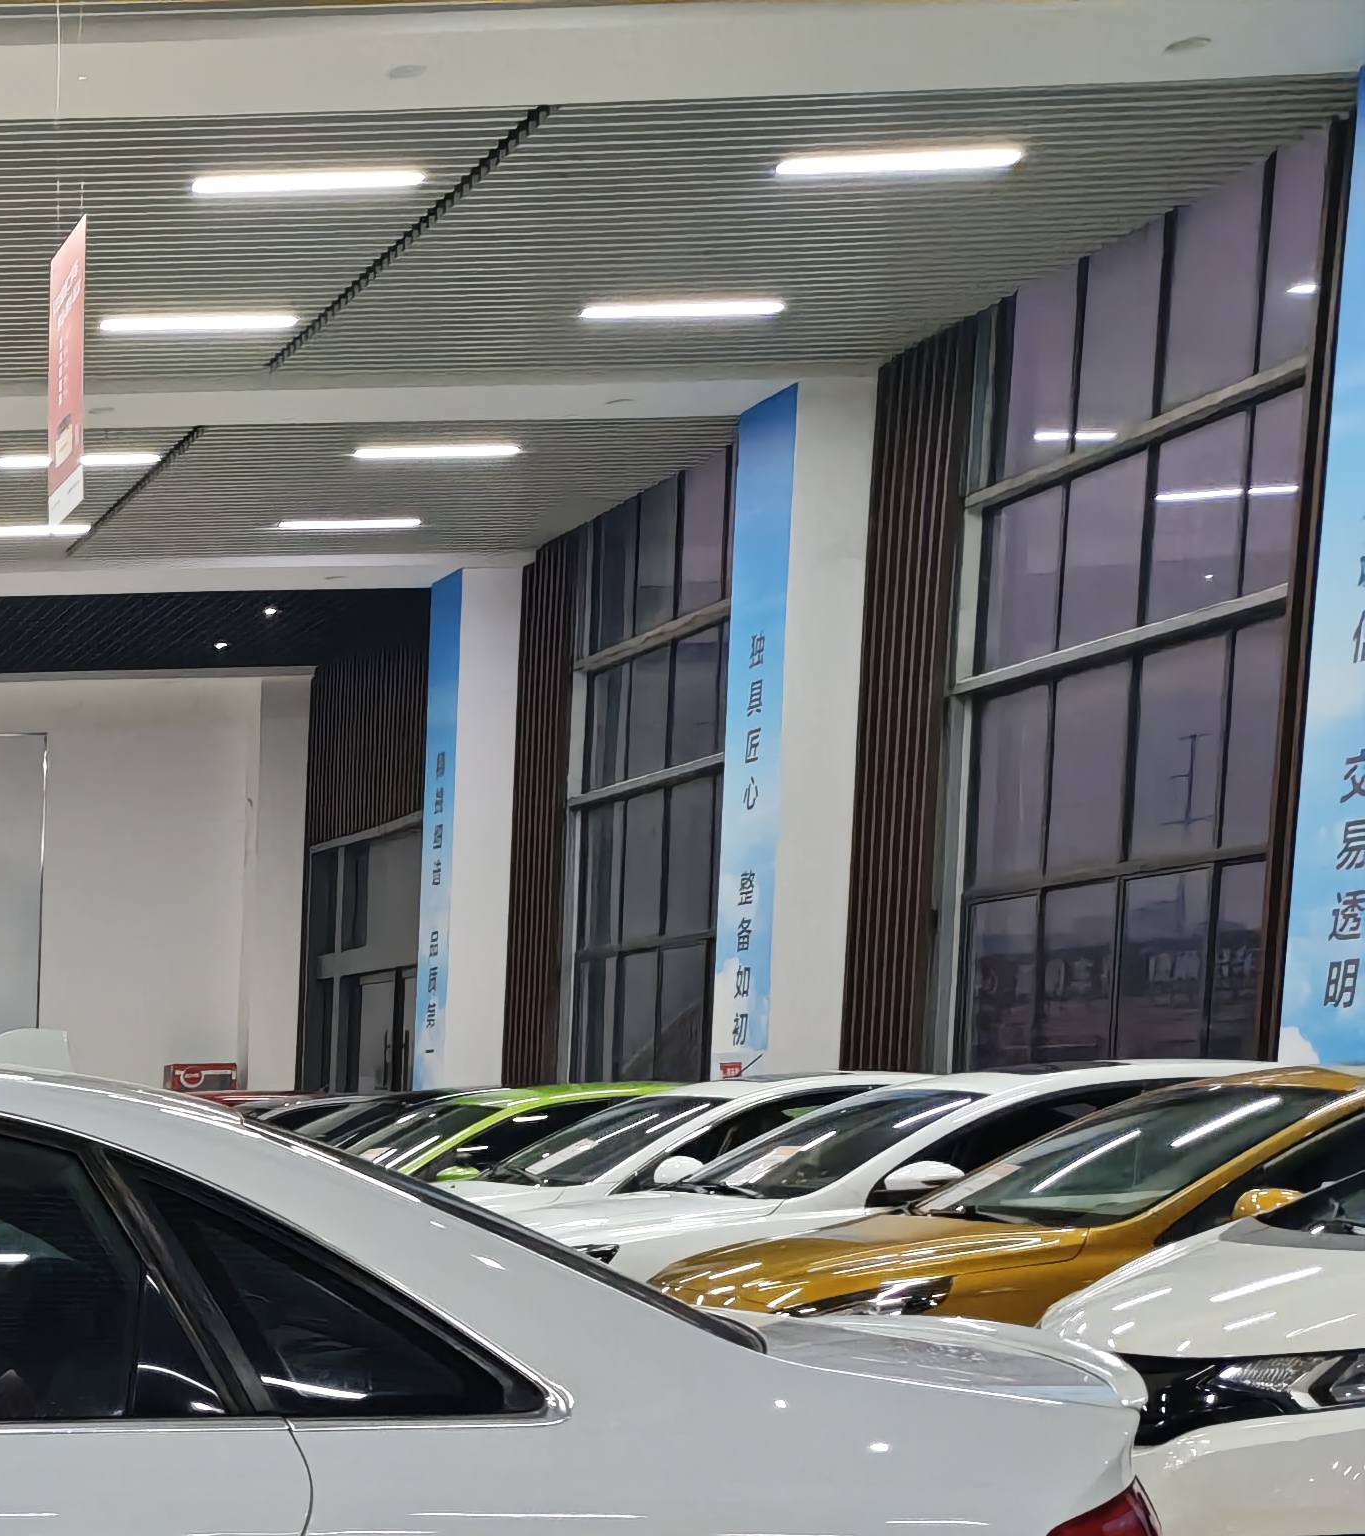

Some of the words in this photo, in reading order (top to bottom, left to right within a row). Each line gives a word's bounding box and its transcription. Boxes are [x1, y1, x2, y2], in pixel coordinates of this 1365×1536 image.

[742, 630, 765, 811] 独具匠心
[732, 870, 756, 1047] 整备如初
[1322, 748, 1365, 1010] 交易透明
